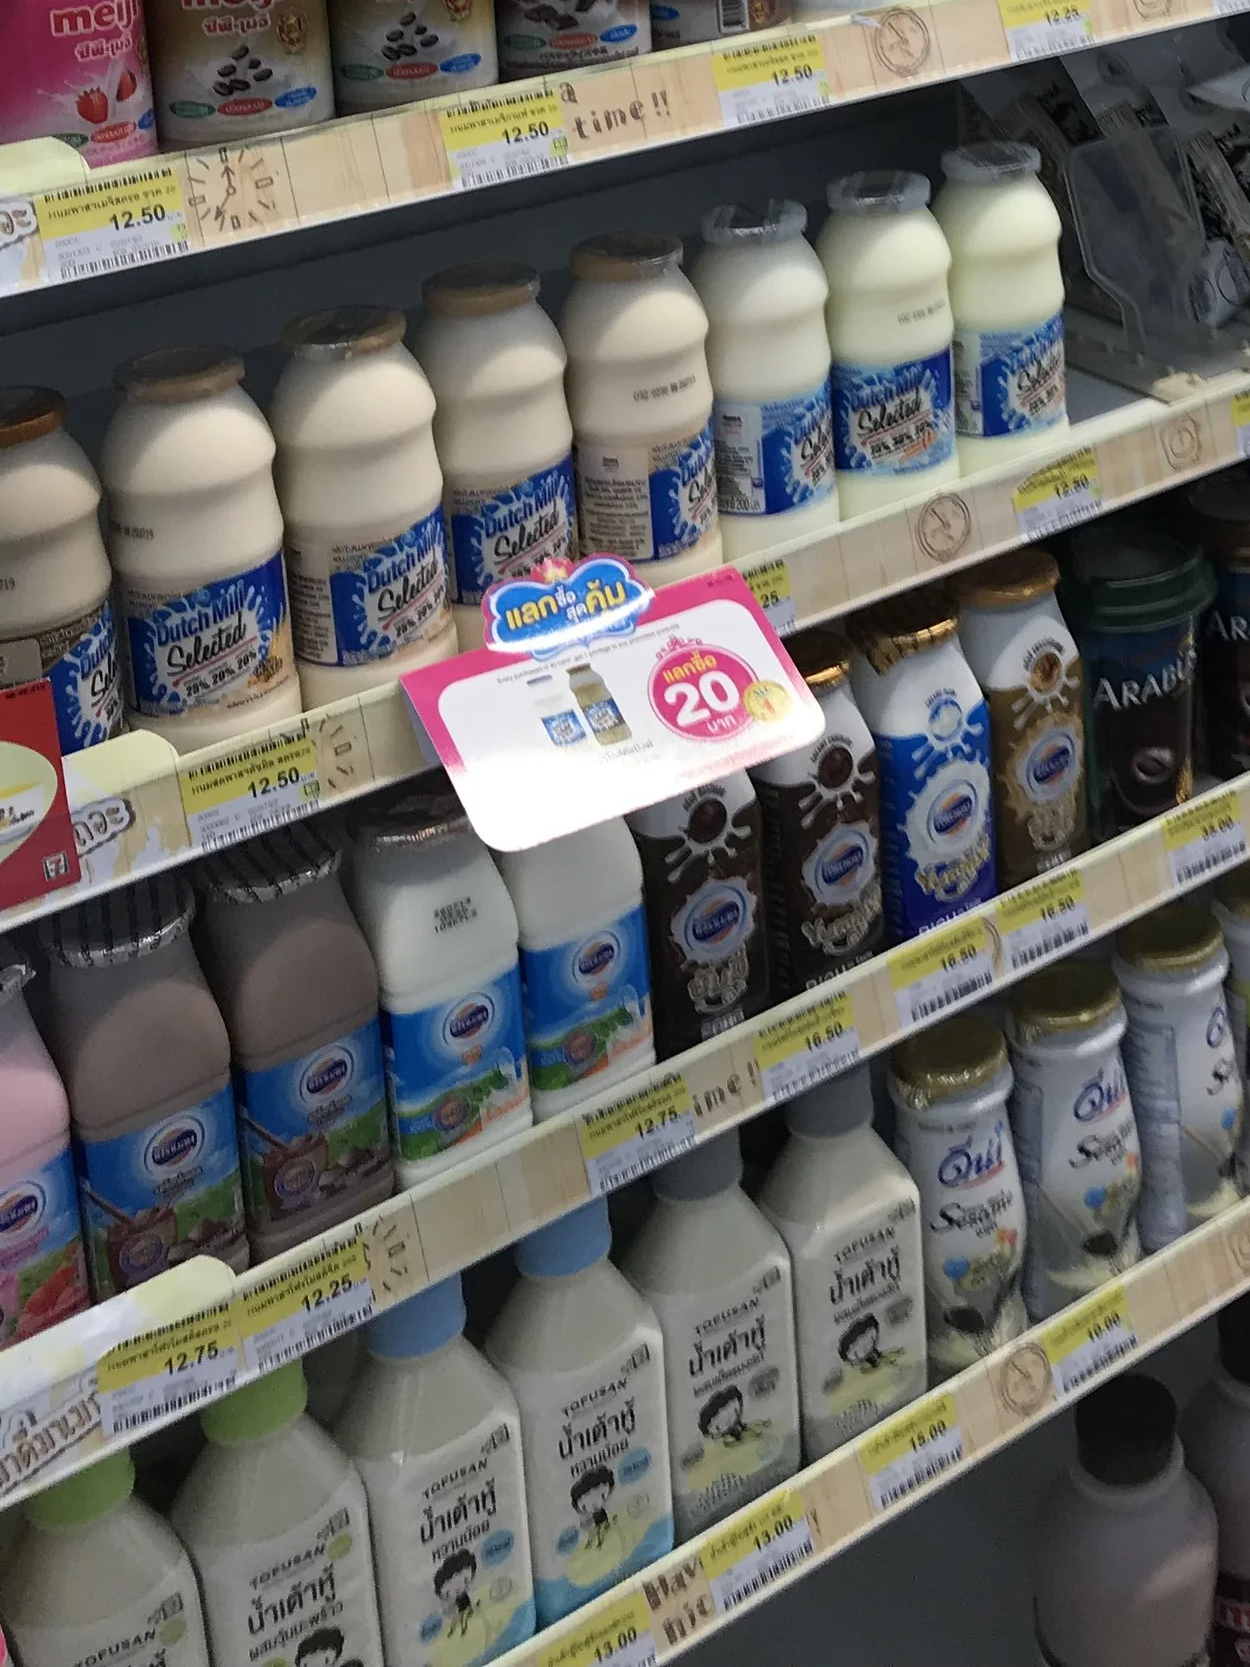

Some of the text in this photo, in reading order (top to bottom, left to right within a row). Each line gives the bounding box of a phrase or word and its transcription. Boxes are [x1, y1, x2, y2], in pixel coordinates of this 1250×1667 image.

[202, 12, 272, 37] ซีพี-เมจิ
[771, 64, 814, 87] 12.50
[501, 120, 550, 146] 12.50
[573, 99, 646, 140] time
[108, 203, 167, 232] 12.50
[483, 499, 533, 539] Dutch
[493, 496, 561, 566] Selected
[365, 547, 416, 594] Dutch
[376, 544, 440, 622] Selected
[156, 579, 246, 646] Dutch Mill
[166, 610, 247, 677] Selected
[661, 644, 718, 684] แลกซื้อ
[663, 669, 742, 728] 20
[705, 714, 738, 734] บาท
[246, 768, 302, 801] 12.50
[634, 1104, 679, 1139] 12.75
[300, 1272, 353, 1313] 12.25
[828, 1244, 900, 1307] น้ำเต้าหู้
[163, 1339, 220, 1377] 12.75
[688, 1313, 767, 1379] น้ำเต้าหู้
[558, 1377, 629, 1420] TOFUSAN
[557, 1395, 637, 1461] น้ำเต้าหู้
[419, 1456, 489, 1501] TOFUSAN
[419, 1477, 498, 1547] น้ำเต้าหู้
[248, 1541, 326, 1591] TOFUSAN
[247, 1562, 336, 1637] น้ำเต้าหู้
